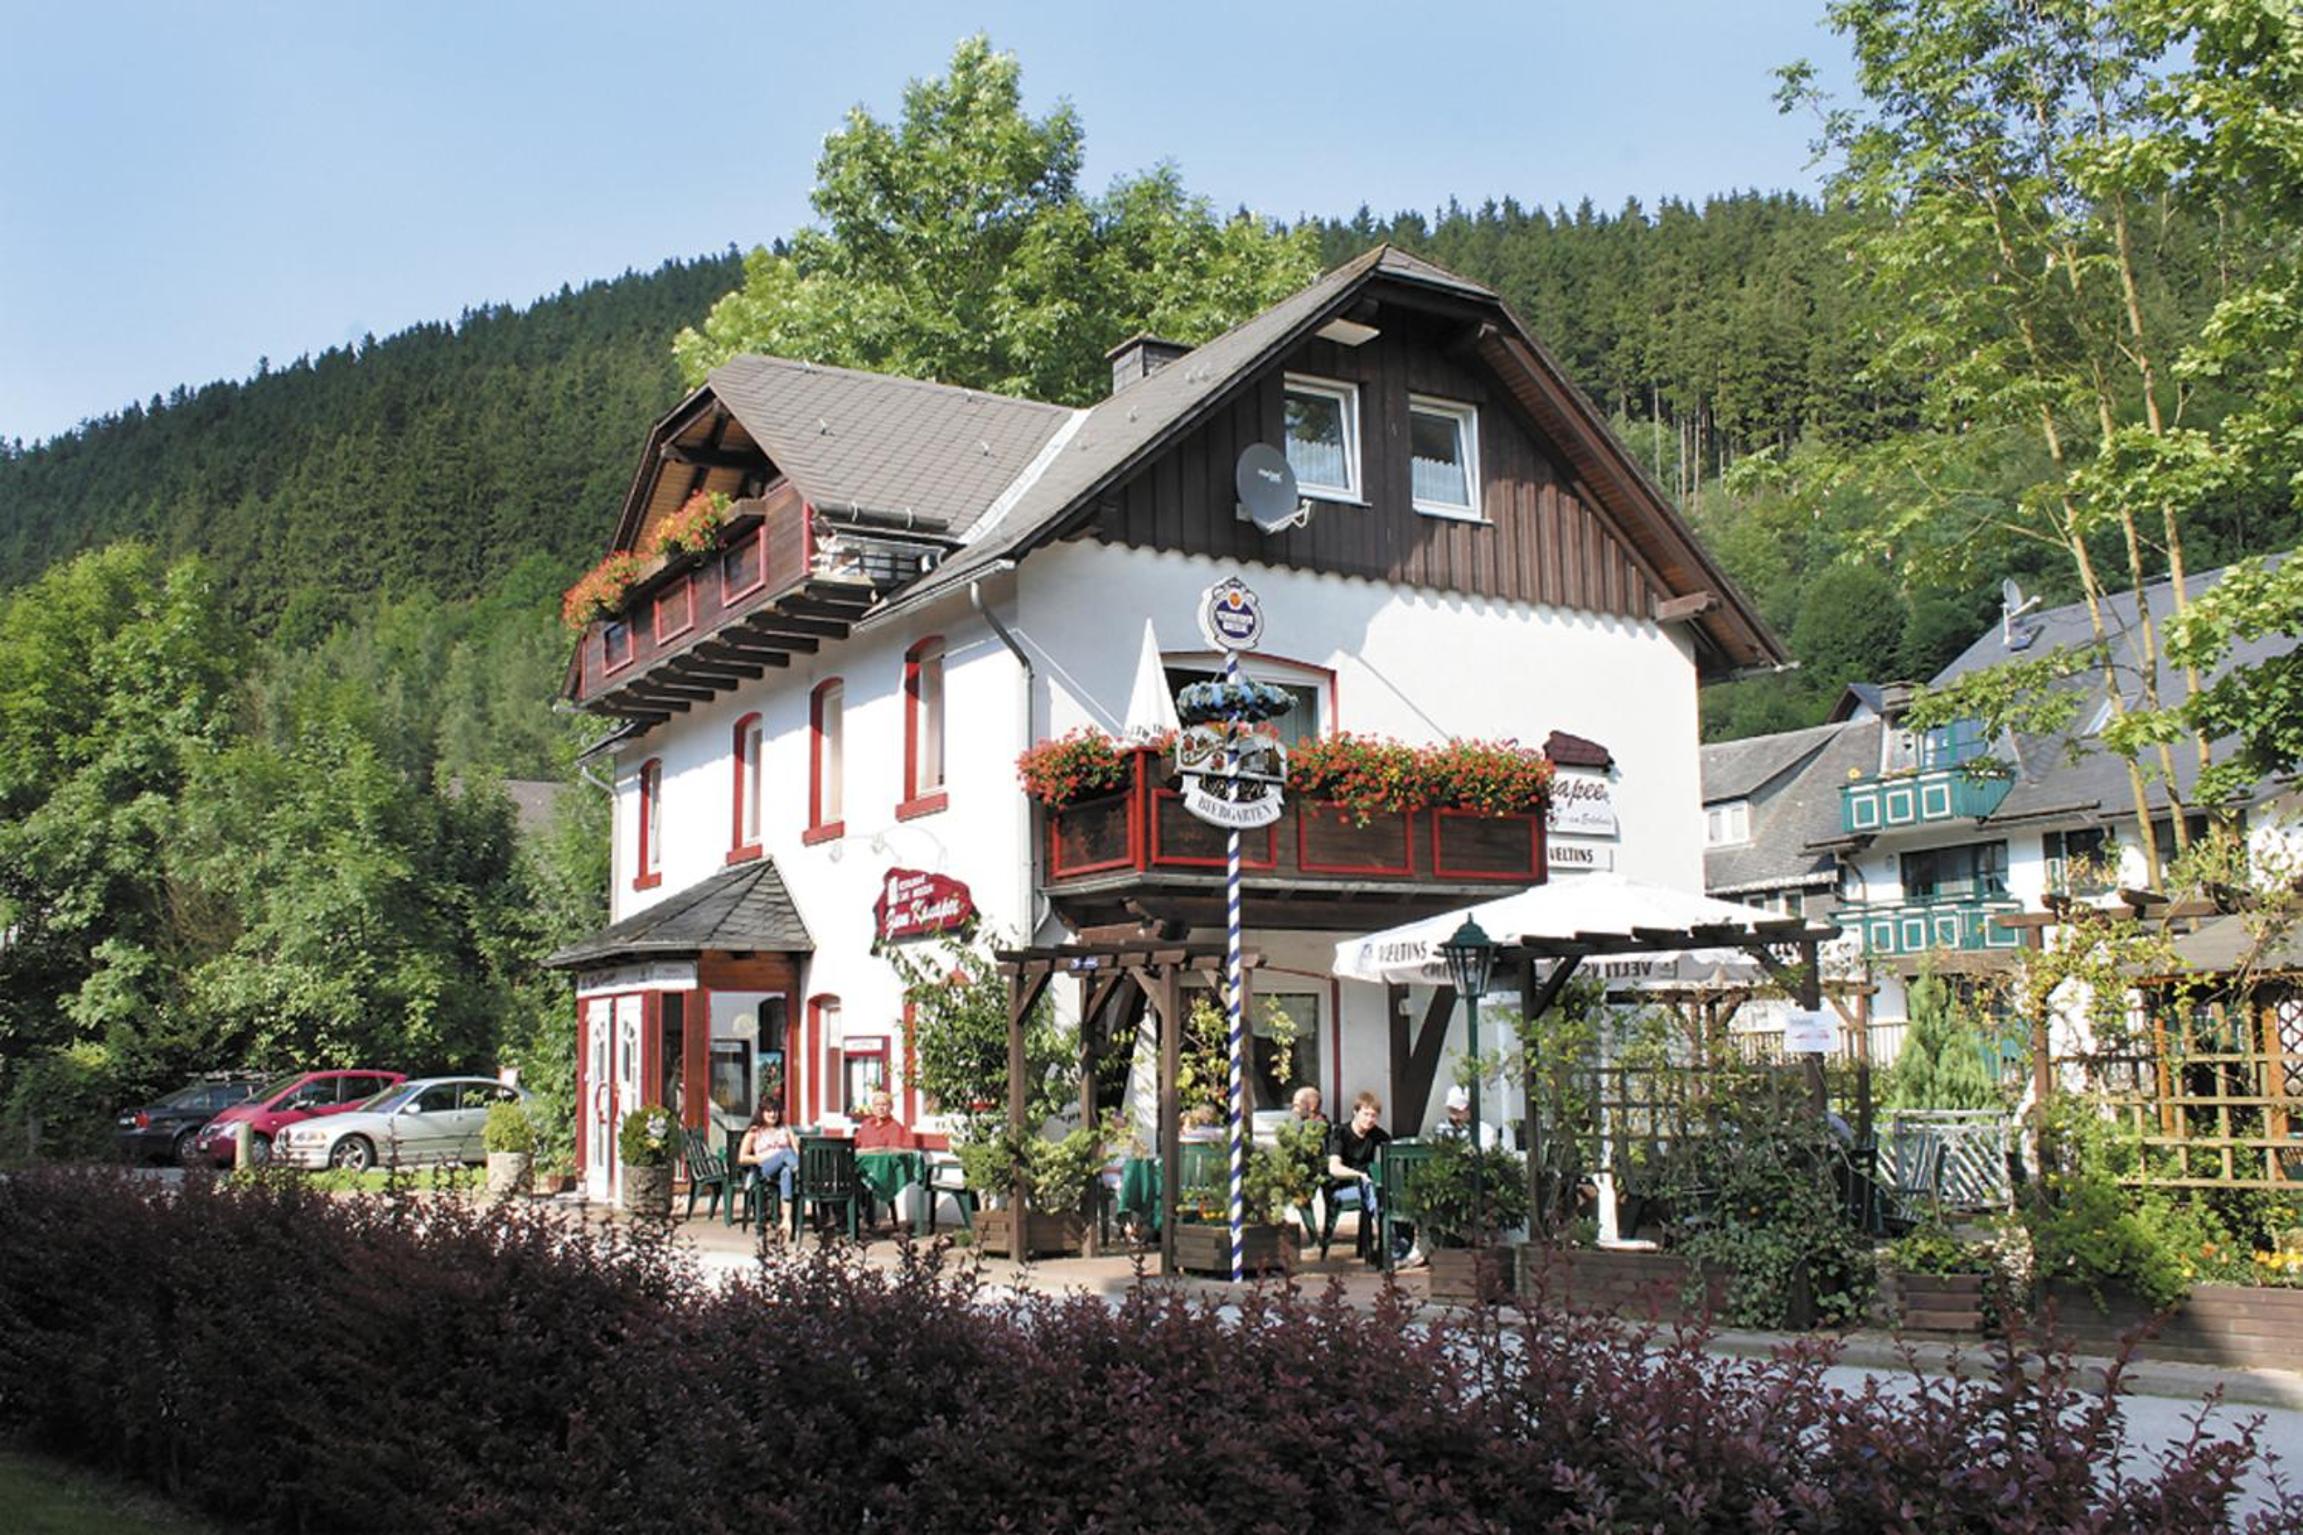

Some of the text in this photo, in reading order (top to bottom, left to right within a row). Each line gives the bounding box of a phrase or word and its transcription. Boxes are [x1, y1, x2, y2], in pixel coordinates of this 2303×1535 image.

[1198, 797, 1273, 822] BIERGARTEN
[1549, 847, 1593, 864] VELTINS
[1379, 941, 1427, 962] VELTINS
